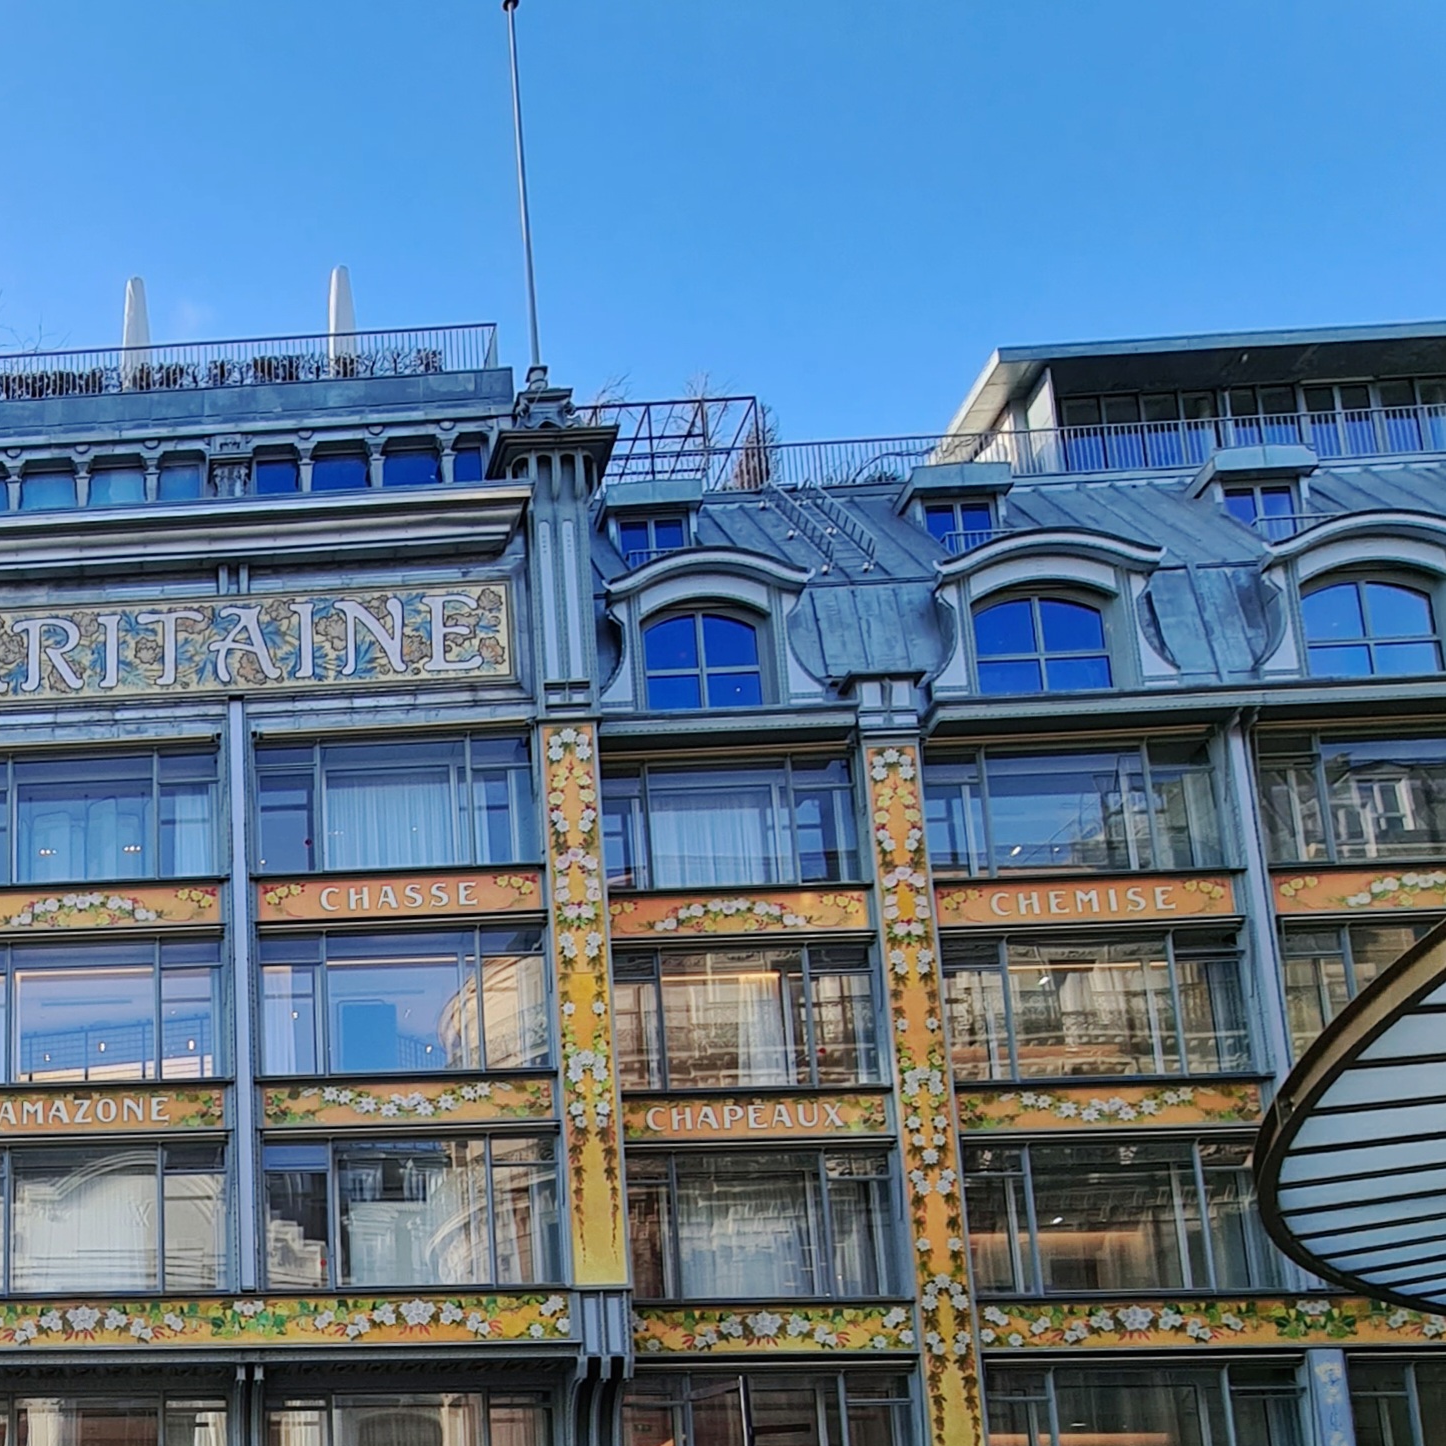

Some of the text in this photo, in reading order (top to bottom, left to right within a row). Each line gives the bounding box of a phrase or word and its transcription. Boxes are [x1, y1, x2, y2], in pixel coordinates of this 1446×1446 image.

[321, 882, 478, 910] CHASSE
[991, 887, 1176, 915] CHEMISE
[645, 1103, 844, 1131] CHAPEAUX
